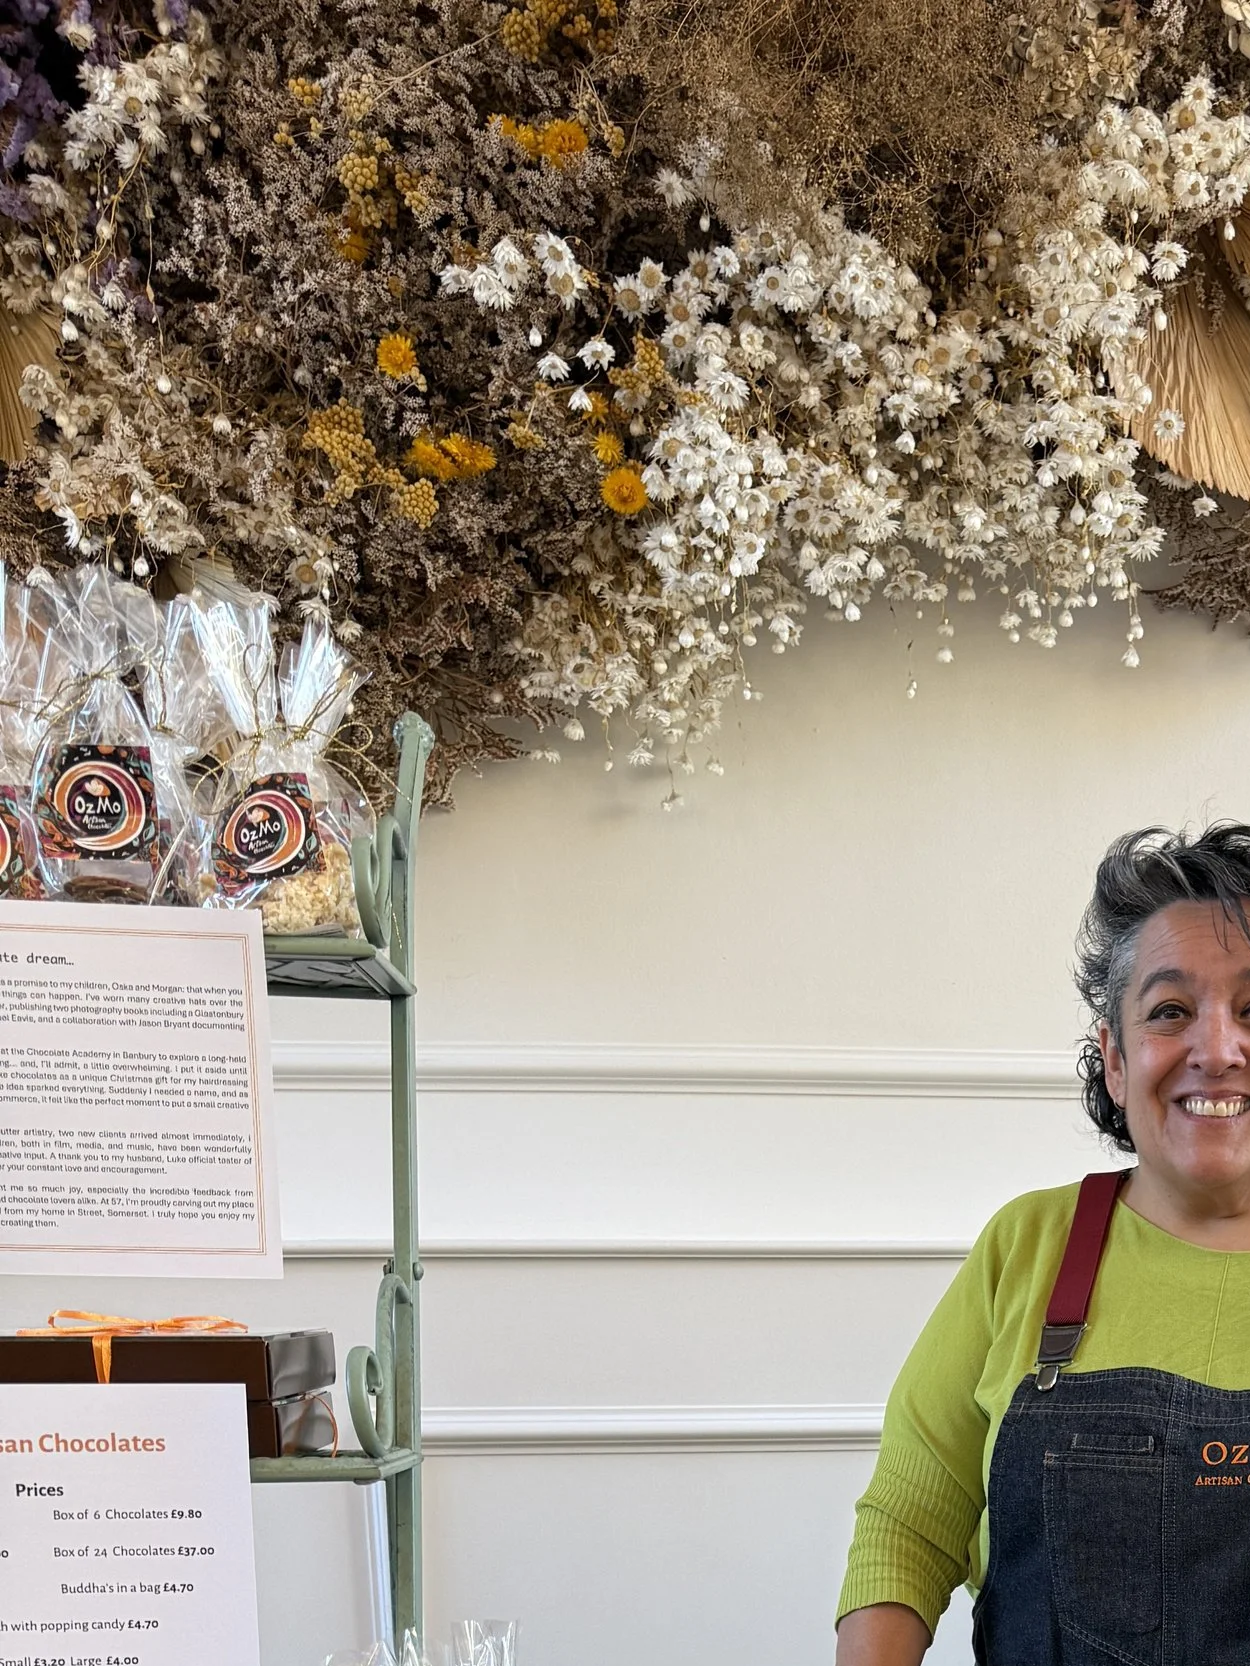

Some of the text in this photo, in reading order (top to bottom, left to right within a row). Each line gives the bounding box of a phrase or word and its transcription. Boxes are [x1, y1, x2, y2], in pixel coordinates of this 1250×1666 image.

[75, 797, 120, 815] OzMo
[241, 820, 280, 843] OzMo
[39, 1432, 165, 1452] Chocolates
[16, 1482, 64, 1497] Prices
[54, 1508, 202, 1520] Box of 6 Chocolates £9.80
[54, 1545, 214, 1558] Box of 24 Chocolates £37.00
[61, 1582, 114, 1594] Buddha's
[117, 1582, 127, 1592] in
[140, 1582, 160, 1594] bag
[163, 1582, 194, 1593] £4.70
[11, 1618, 158, 1632] with popping candy £4.70
[106, 1656, 138, 1666] £4.00
